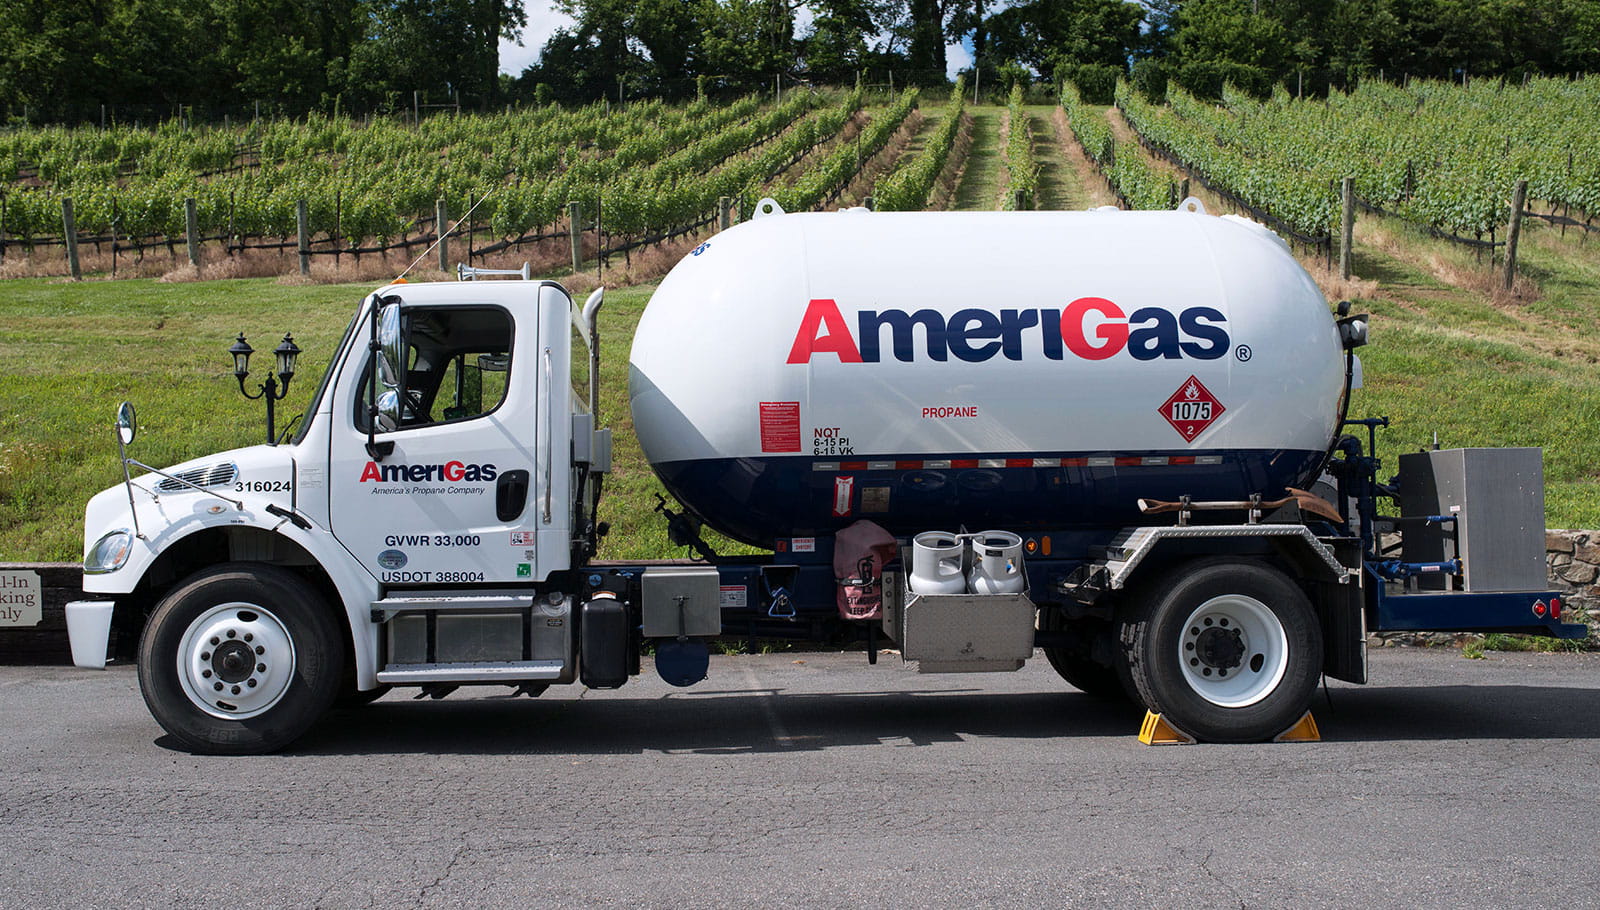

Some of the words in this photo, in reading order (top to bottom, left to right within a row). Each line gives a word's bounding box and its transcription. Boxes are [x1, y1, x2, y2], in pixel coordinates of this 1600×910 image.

[786, 296, 1231, 364] AmeriGas
[922, 407, 977, 418] PROPANE
[1174, 402, 1210, 420] 1075
[814, 428, 840, 438] NQT
[1187, 425, 1194, 435] 2
[813, 438, 836, 447] 6-15
[839, 437, 850, 446] PI
[838, 446, 854, 455] VK
[360, 460, 497, 483] AmeriGas
[235, 480, 292, 493] 316024
[371, 486, 410, 495] America's
[411, 486, 446, 496] Propane
[447, 485, 486, 496] Company
[385, 535, 430, 547] GVWR
[434, 535, 481, 548] 33,000
[0, 576, 29, 588] l-In
[381, 571, 432, 582] USDOT
[435, 571, 485, 582] 388004
